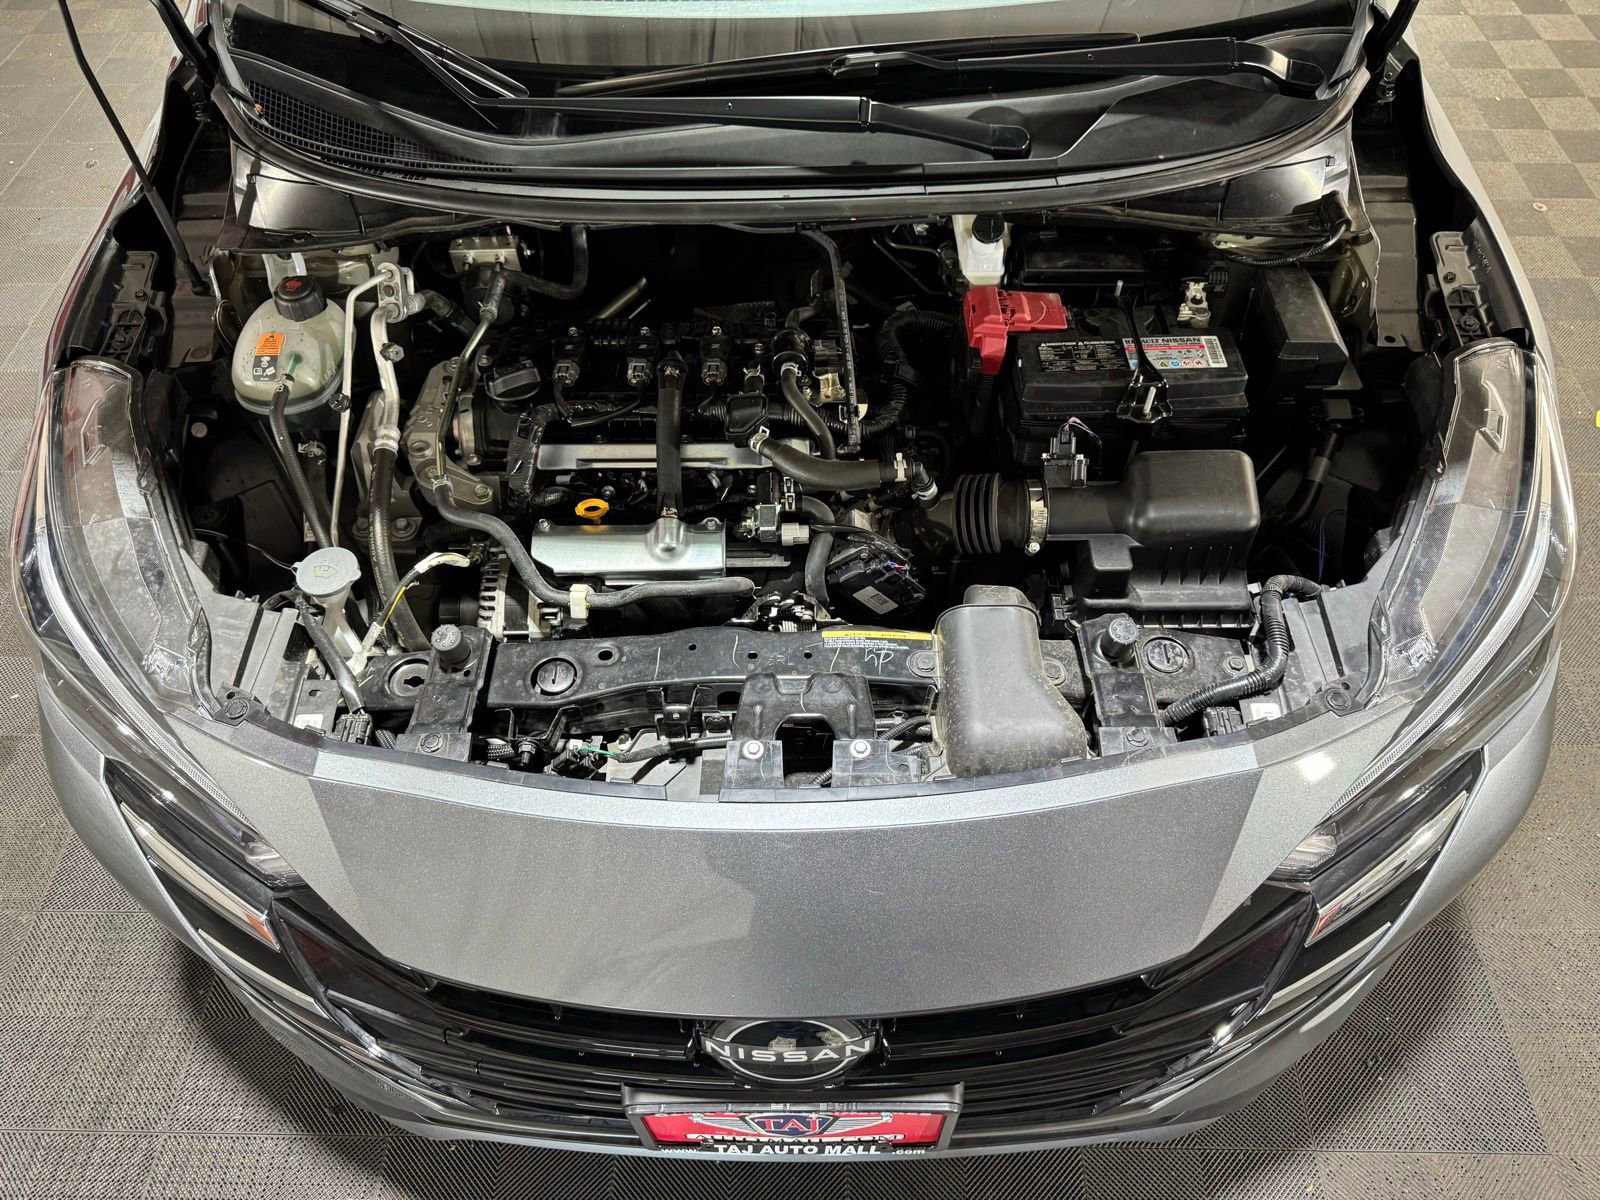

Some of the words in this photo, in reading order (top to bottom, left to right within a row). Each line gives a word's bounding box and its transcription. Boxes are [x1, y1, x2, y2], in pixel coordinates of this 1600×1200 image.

[705, 1039, 870, 1063] NISSAN
[754, 1116, 822, 1135] TAJ
[713, 1144, 753, 1155] TAJ
[760, 1144, 818, 1155] AUTO
[824, 1145, 881, 1156] MALL
